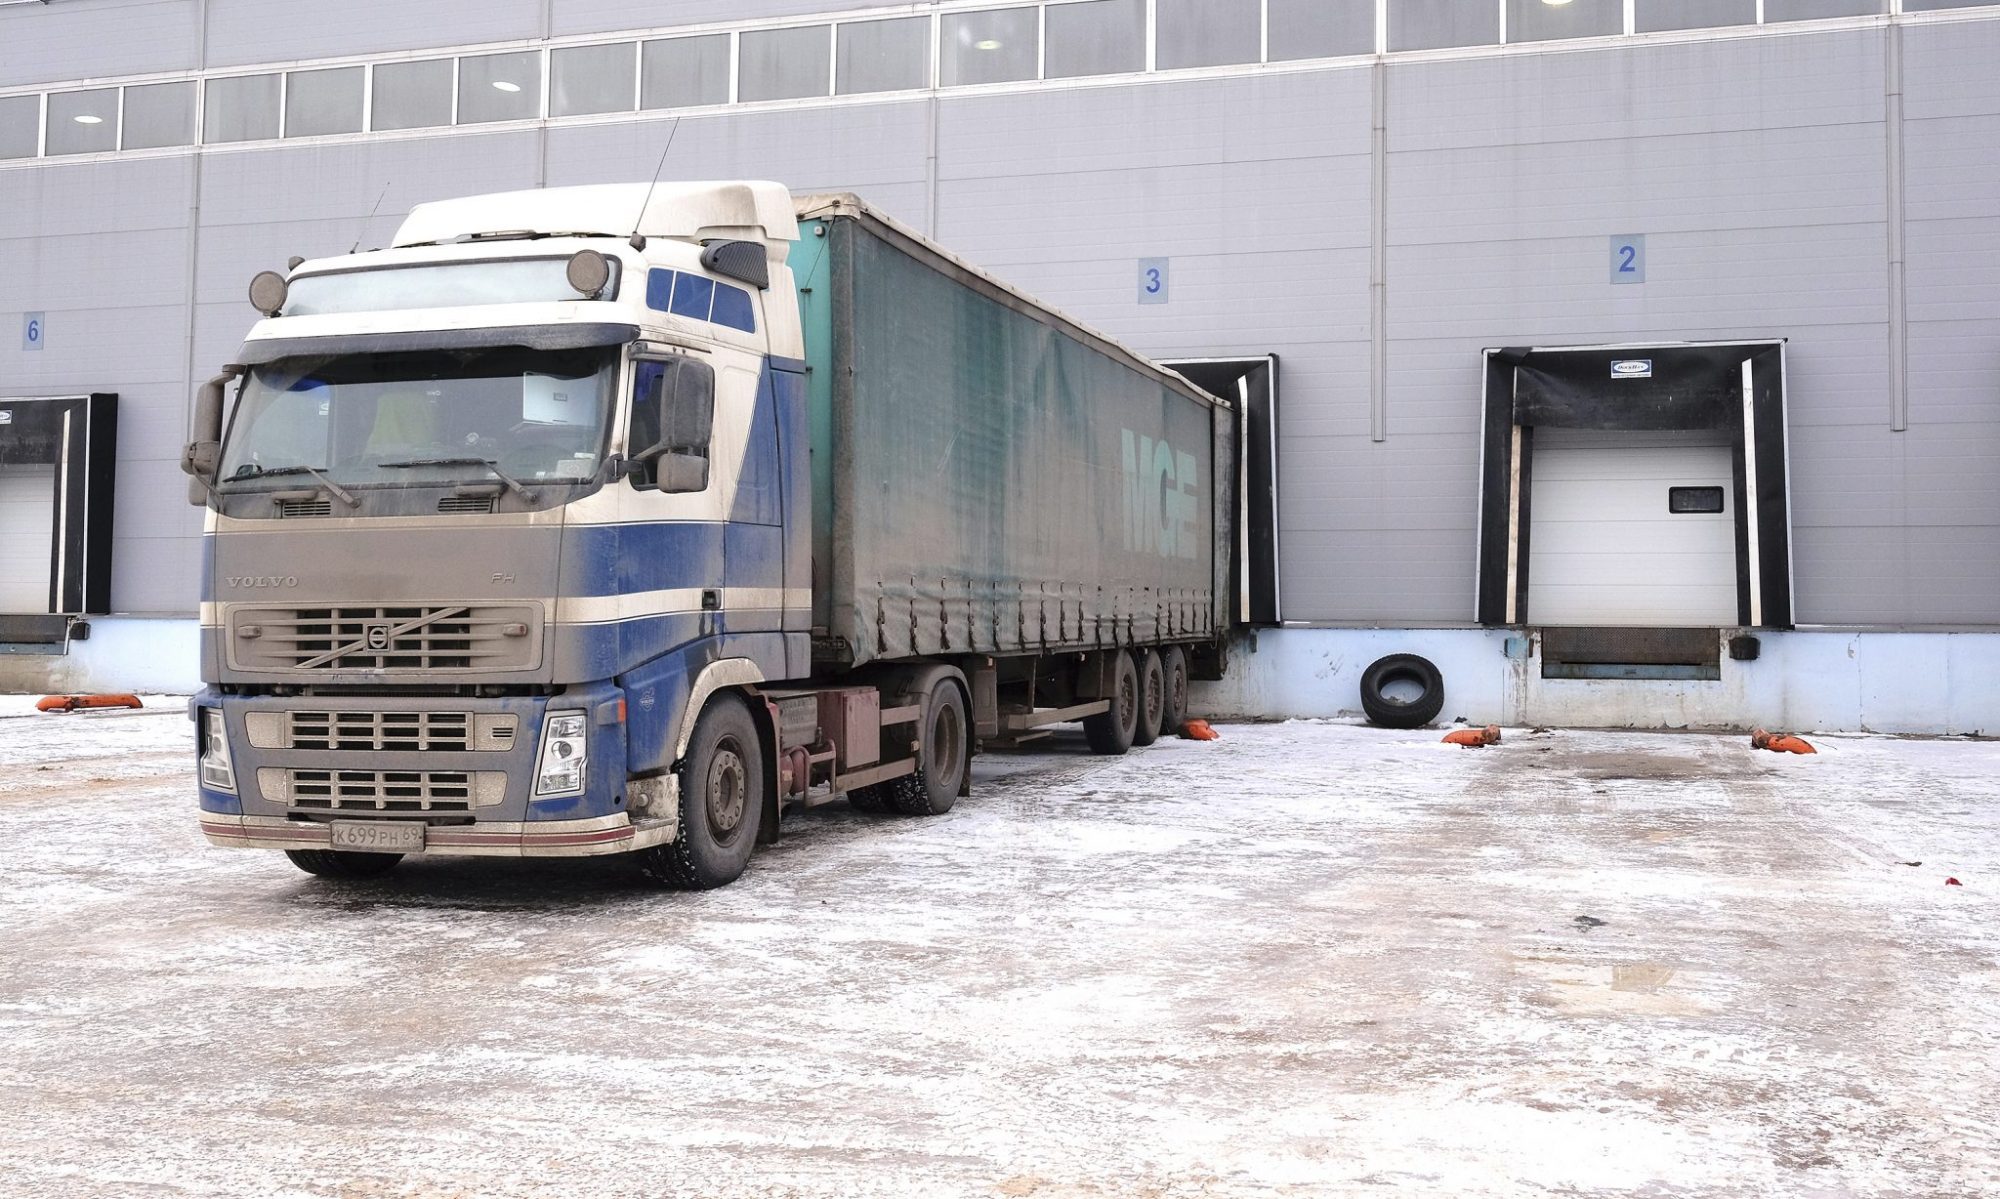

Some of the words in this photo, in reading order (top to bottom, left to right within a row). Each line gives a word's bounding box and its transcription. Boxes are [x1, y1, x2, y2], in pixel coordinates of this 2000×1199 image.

[1619, 245, 1636, 272] 2
[1146, 268, 1161, 293] 3
[28, 320, 38, 341] 6
[224, 576, 299, 588] VOLVO
[491, 572, 516, 584] FH
